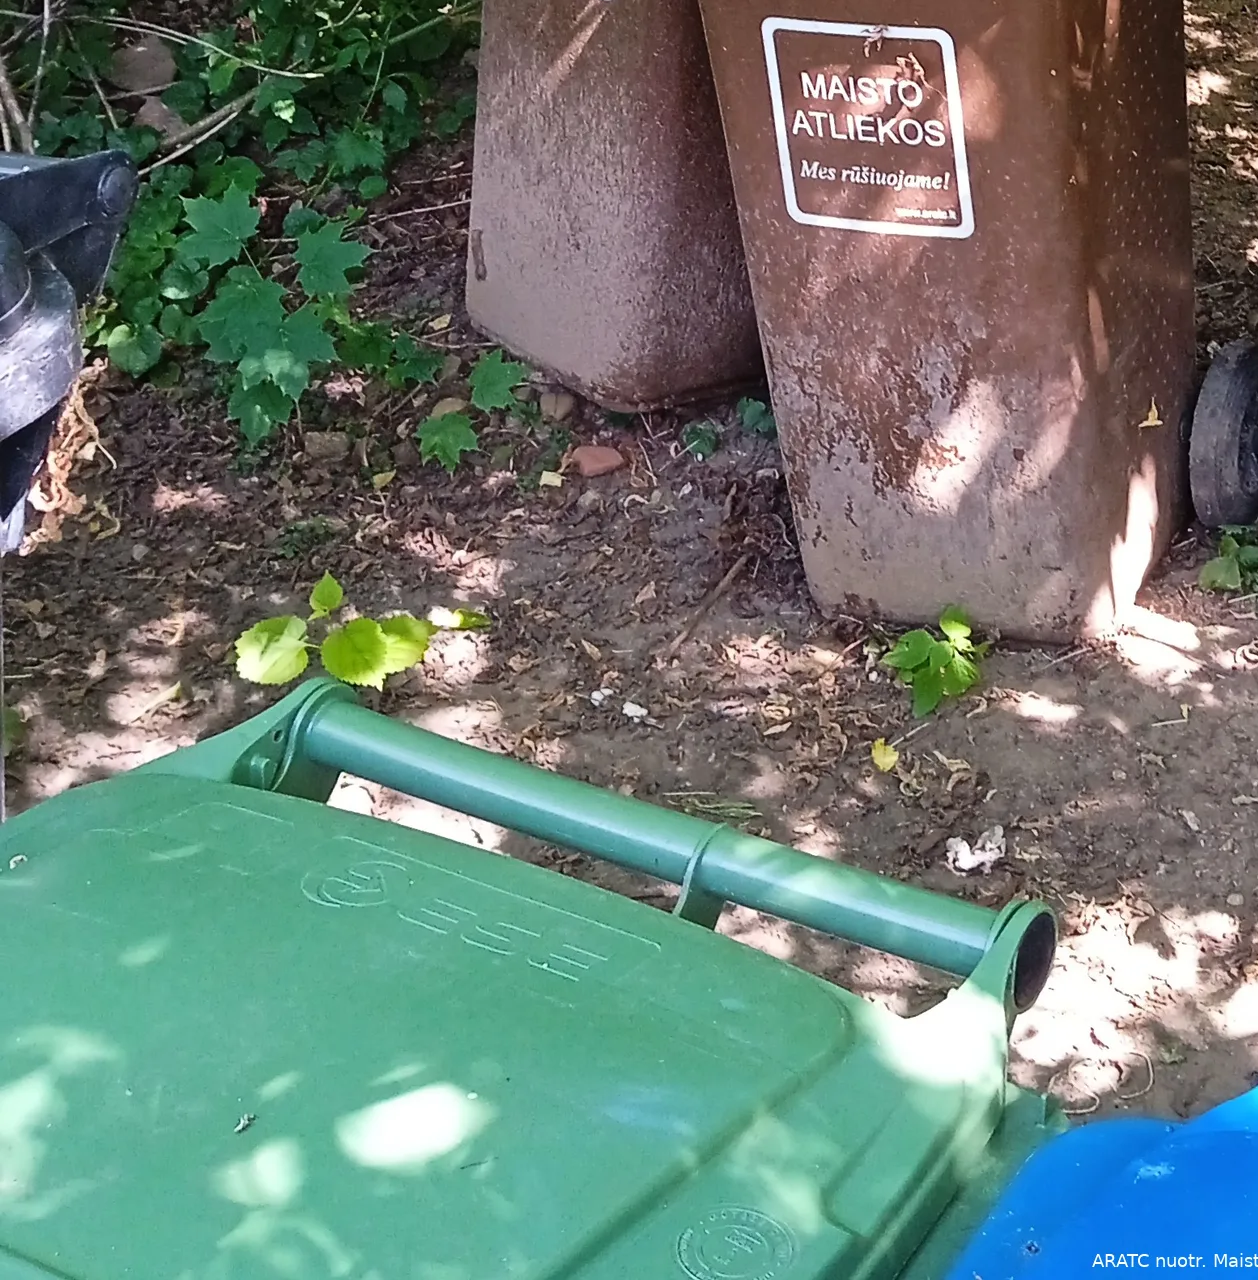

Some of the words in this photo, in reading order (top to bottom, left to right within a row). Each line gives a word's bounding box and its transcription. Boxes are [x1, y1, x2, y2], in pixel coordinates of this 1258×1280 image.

[800, 71, 923, 108] MAISTO
[791, 109, 946, 147] ATLIEKOS
[800, 159, 842, 181] Mes
[842, 166, 951, 192] rūšiuojame!
